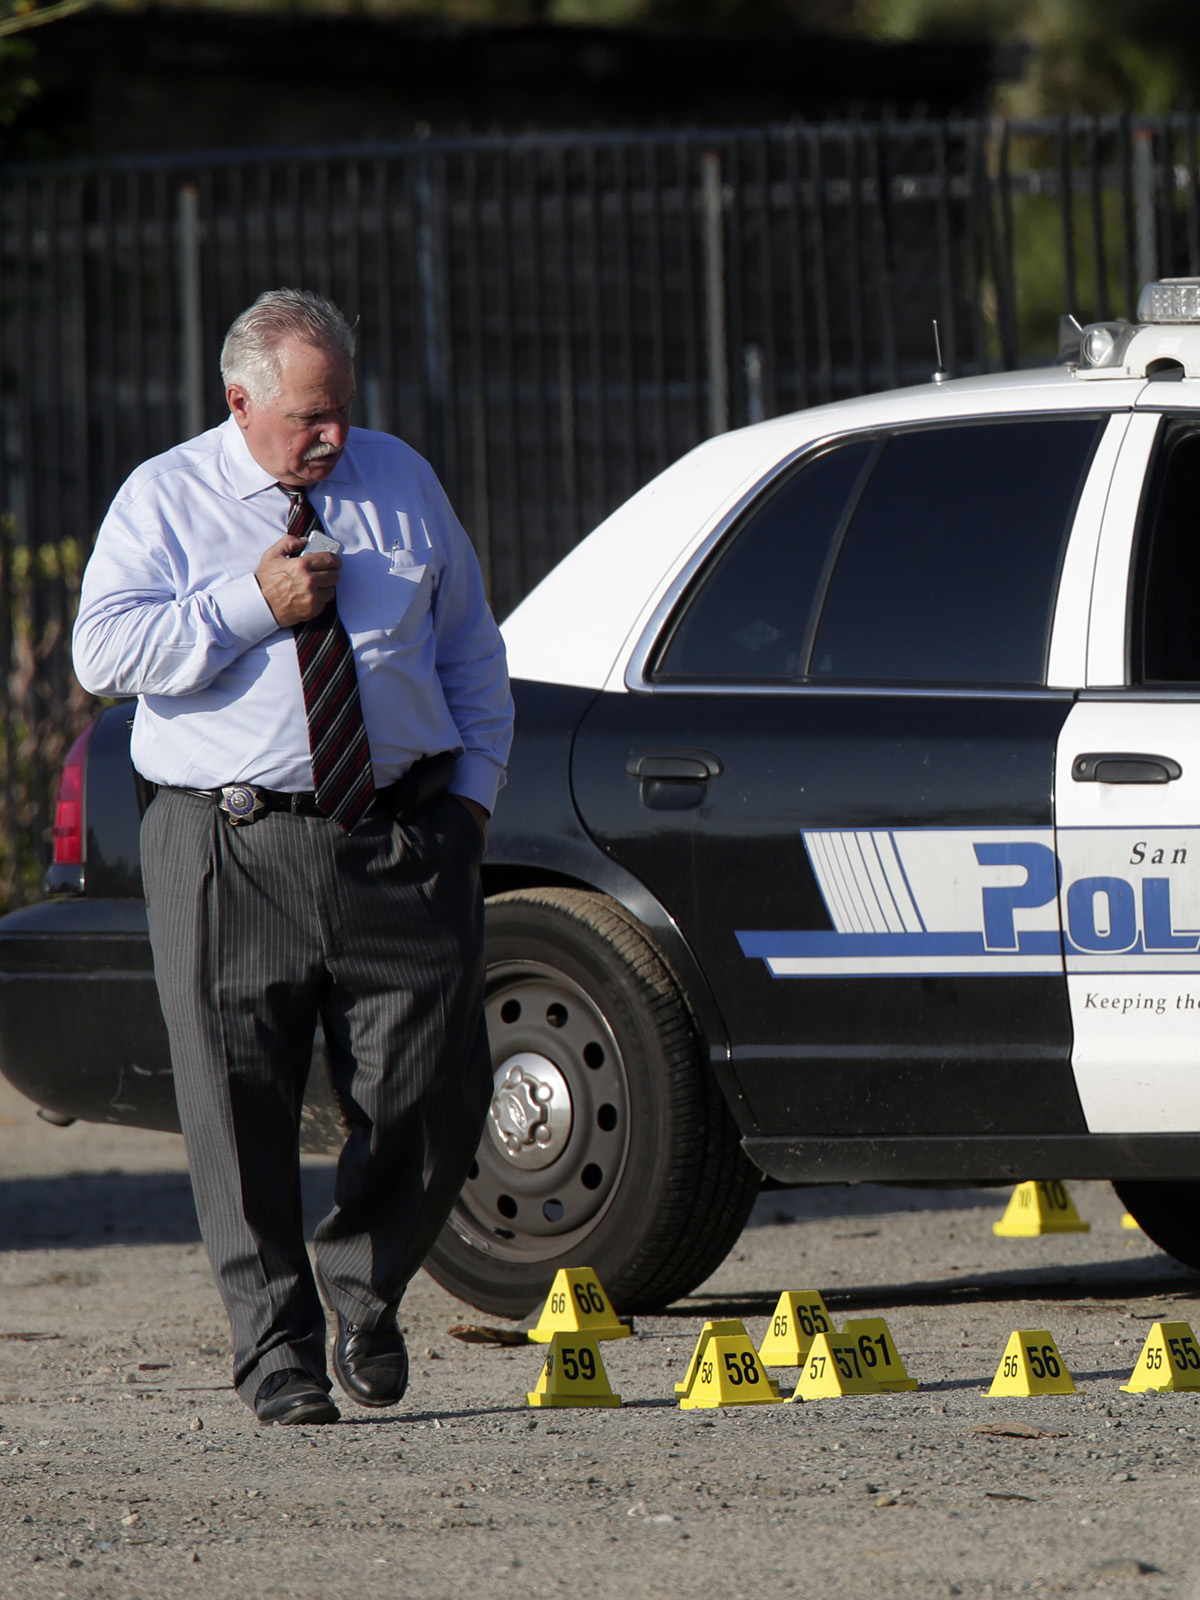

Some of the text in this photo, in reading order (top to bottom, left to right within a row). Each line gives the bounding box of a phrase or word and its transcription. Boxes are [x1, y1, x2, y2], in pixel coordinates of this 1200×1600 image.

[1129, 841, 1188, 865] San
[1084, 992, 1167, 1015] Keeping
[551, 1293, 565, 1314] 66
[574, 1282, 605, 1314] 66
[773, 1315, 787, 1337] 65
[797, 1305, 829, 1336] 65
[562, 1348, 596, 1380] 59
[832, 1348, 863, 1379] 57
[858, 1333, 891, 1368] 61
[1026, 1345, 1061, 1379] 56
[1146, 1347, 1162, 1370] 55
[1168, 1337, 1200, 1370] 55
[701, 1362, 713, 1384] 58
[724, 1352, 759, 1385] 58
[810, 1356, 826, 1380] 57
[1003, 1354, 1018, 1378] 56
